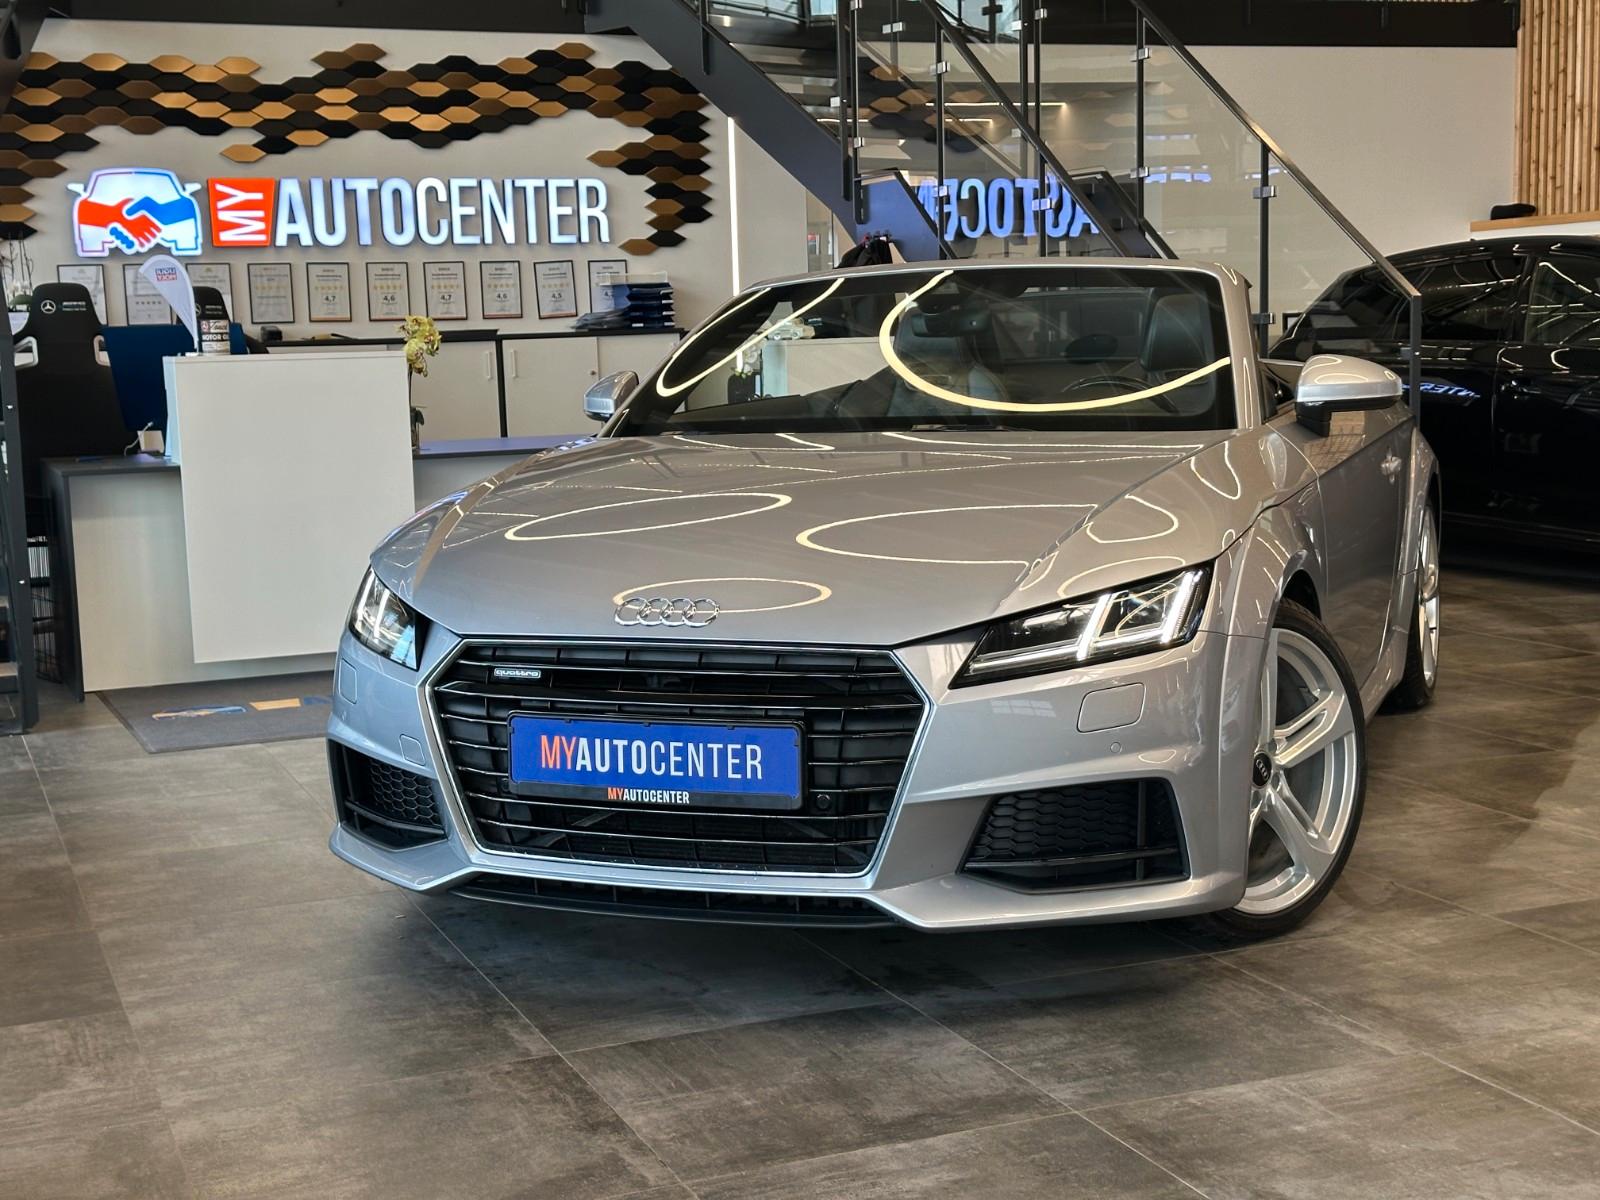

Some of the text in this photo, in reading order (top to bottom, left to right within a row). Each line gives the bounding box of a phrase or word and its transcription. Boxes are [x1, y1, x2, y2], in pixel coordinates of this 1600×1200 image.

[214, 177, 611, 247] MY AUTOCENTER
[495, 669, 539, 677] quattro
[540, 734, 763, 780] MYAUTOCENTER
[607, 787, 690, 804] MYAUTOCENTER
